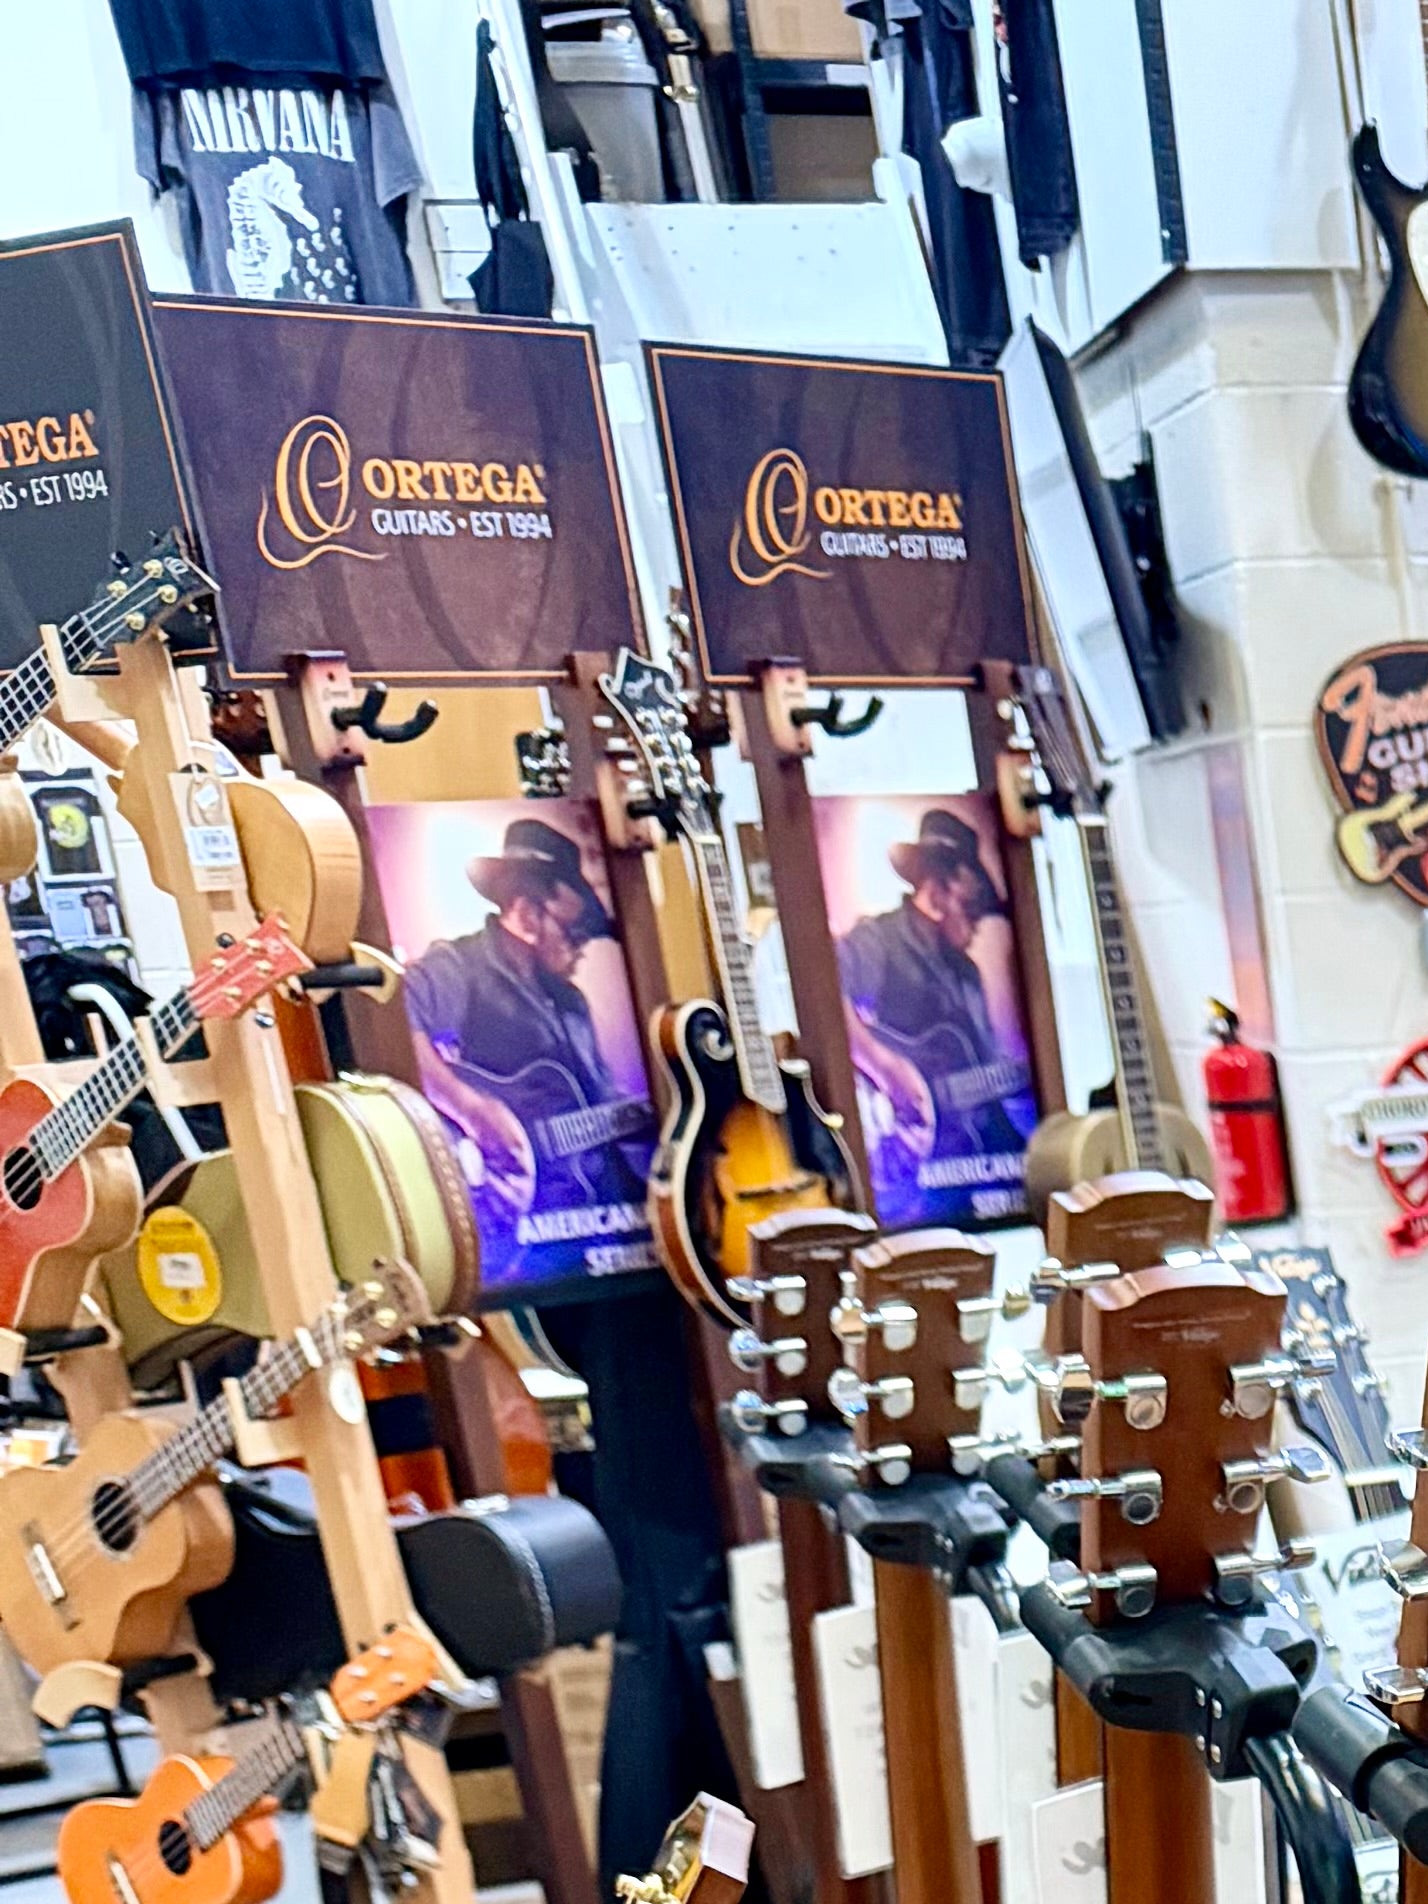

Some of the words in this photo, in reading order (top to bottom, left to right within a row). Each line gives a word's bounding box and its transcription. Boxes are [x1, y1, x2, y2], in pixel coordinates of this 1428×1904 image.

[181, 87, 355, 162] NIRVANA
[0, 411, 98, 468] TEGA
[30, 475, 62, 506] EST
[65, 470, 109, 501] 1994
[363, 458, 547, 504] ORTEGA
[371, 509, 456, 537] GUITARS
[471, 511, 504, 538] EST
[508, 512, 552, 540] 1994
[814, 487, 963, 530] ORTEGA
